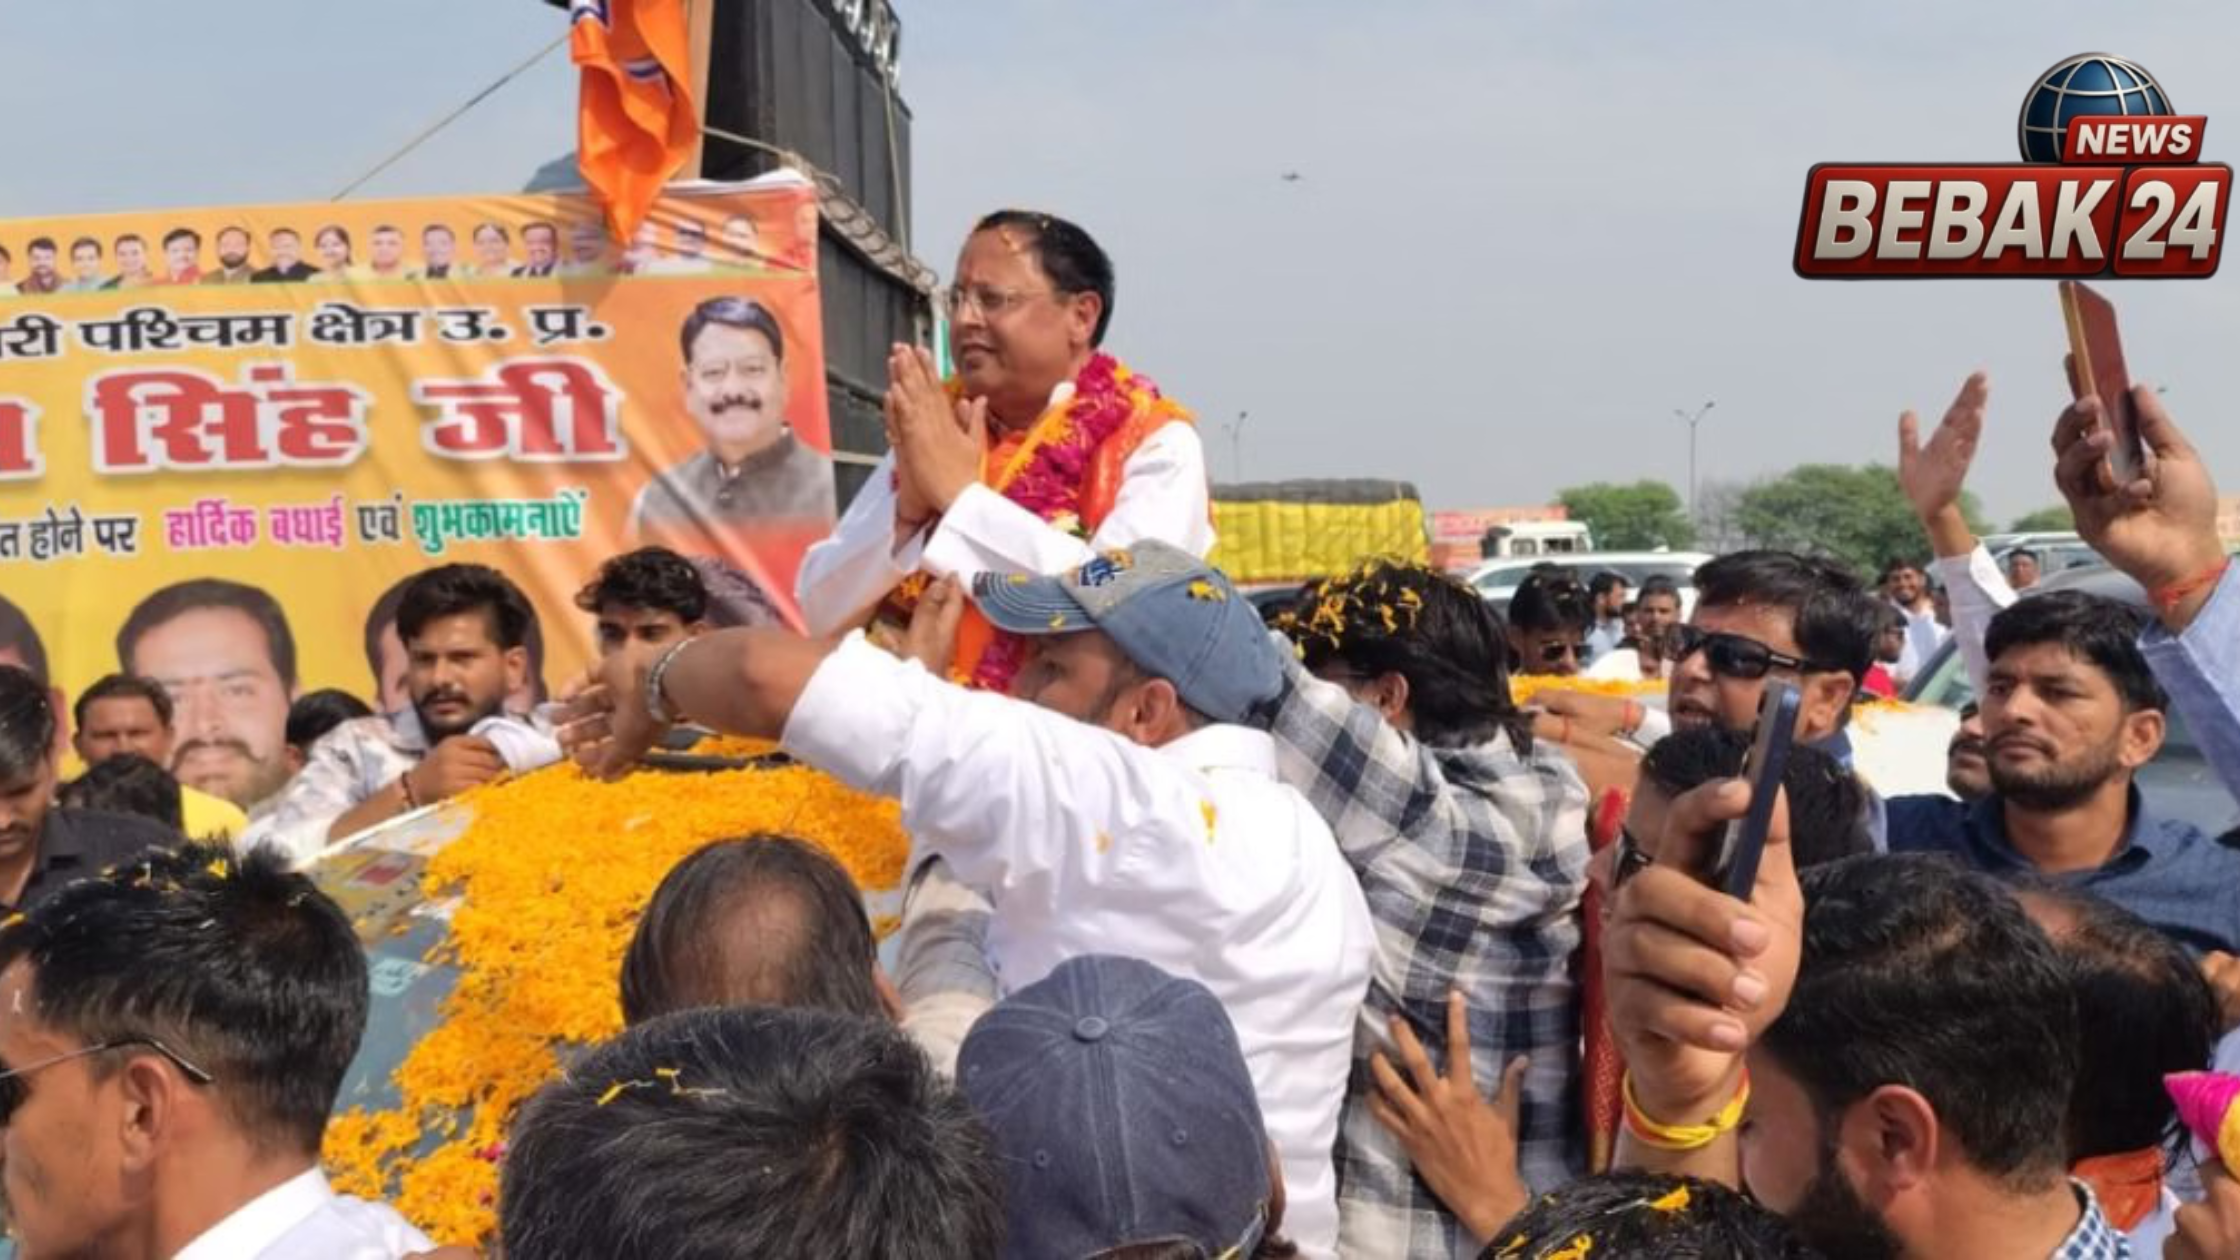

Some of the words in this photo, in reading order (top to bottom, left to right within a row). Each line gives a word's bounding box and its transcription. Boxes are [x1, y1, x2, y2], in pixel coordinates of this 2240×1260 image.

[0, 314, 62, 357] री
[79, 307, 292, 351] पश्चिम
[311, 303, 420, 343] क्षेत्र
[437, 309, 507, 340] उ.
[529, 307, 606, 345] प्र.
[93, 366, 362, 466] सिंह
[422, 361, 617, 455] जी
[29, 507, 83, 559] होने
[92, 517, 137, 552] पर
[166, 500, 256, 548] हार्दिक
[270, 495, 343, 546] बधाई
[357, 494, 402, 541] एवं
